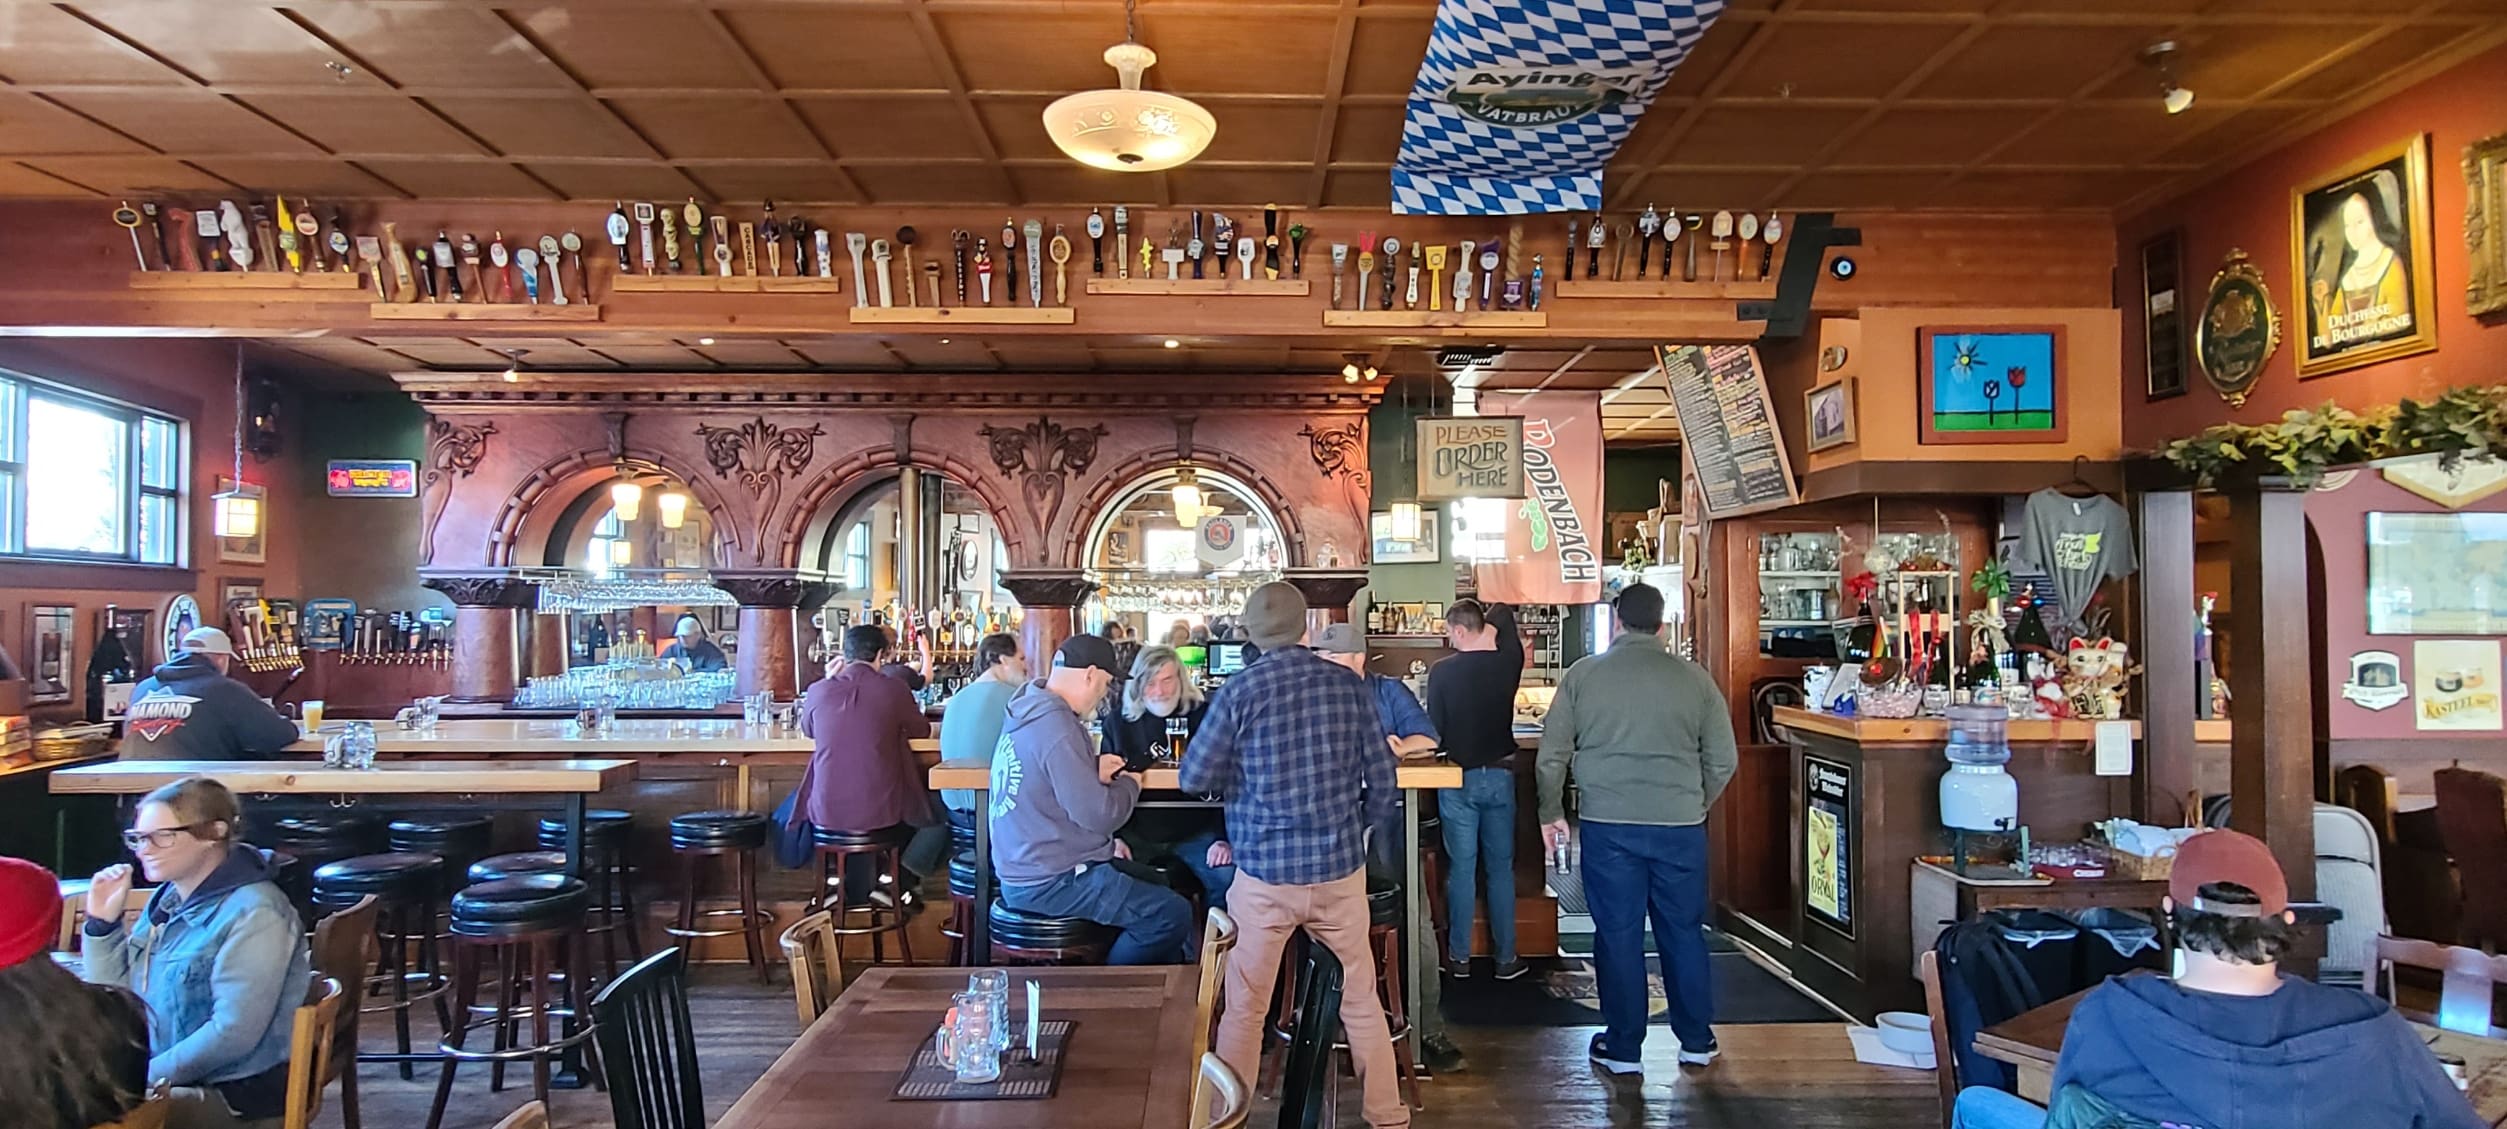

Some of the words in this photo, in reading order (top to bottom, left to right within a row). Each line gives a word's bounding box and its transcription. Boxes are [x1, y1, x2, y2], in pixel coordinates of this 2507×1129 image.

[1477, 101, 1582, 123] VATBRAU
[2331, 313, 2412, 343] BOURGOGNE
[1436, 425, 1507, 446] PLEASE
[1435, 442, 1508, 479] ORDER
[1457, 466, 1508, 487] HERE
[1523, 418, 1598, 583] RODENBACH
